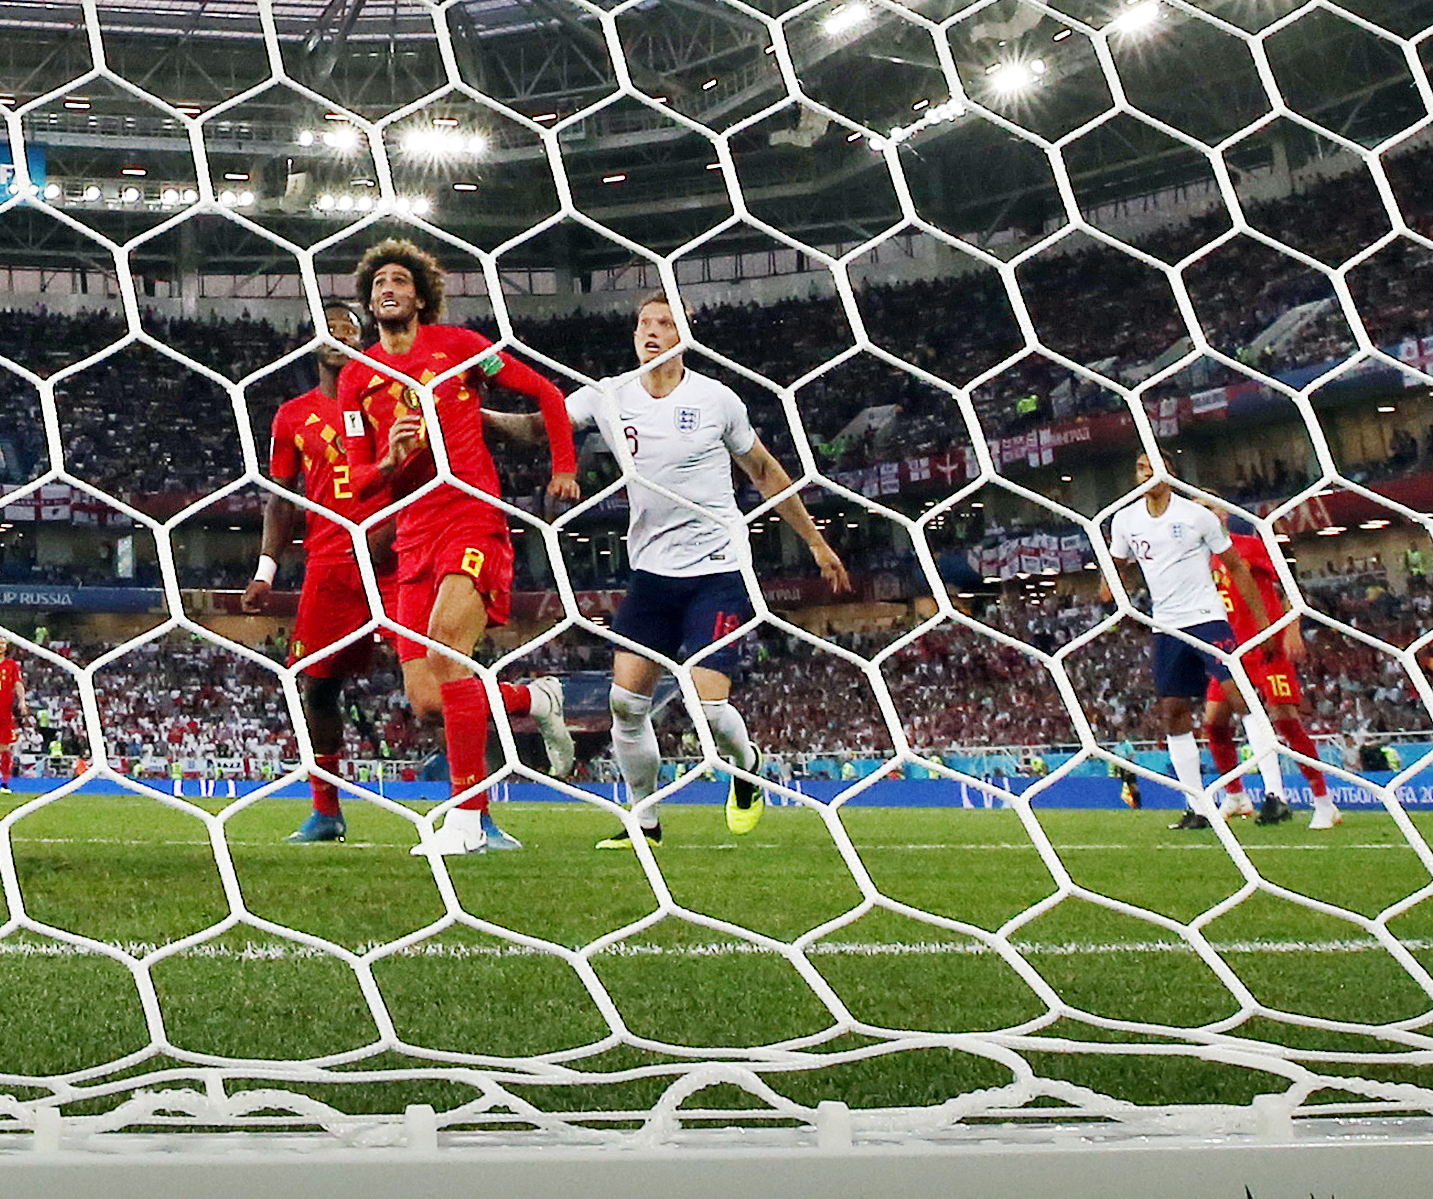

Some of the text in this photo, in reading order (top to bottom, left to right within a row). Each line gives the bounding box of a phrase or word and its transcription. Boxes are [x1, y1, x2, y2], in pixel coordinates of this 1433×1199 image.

[461, 547, 485, 578] 8
[20, 592, 73, 606] RUSSIA
[1266, 674, 1292, 697] 16
